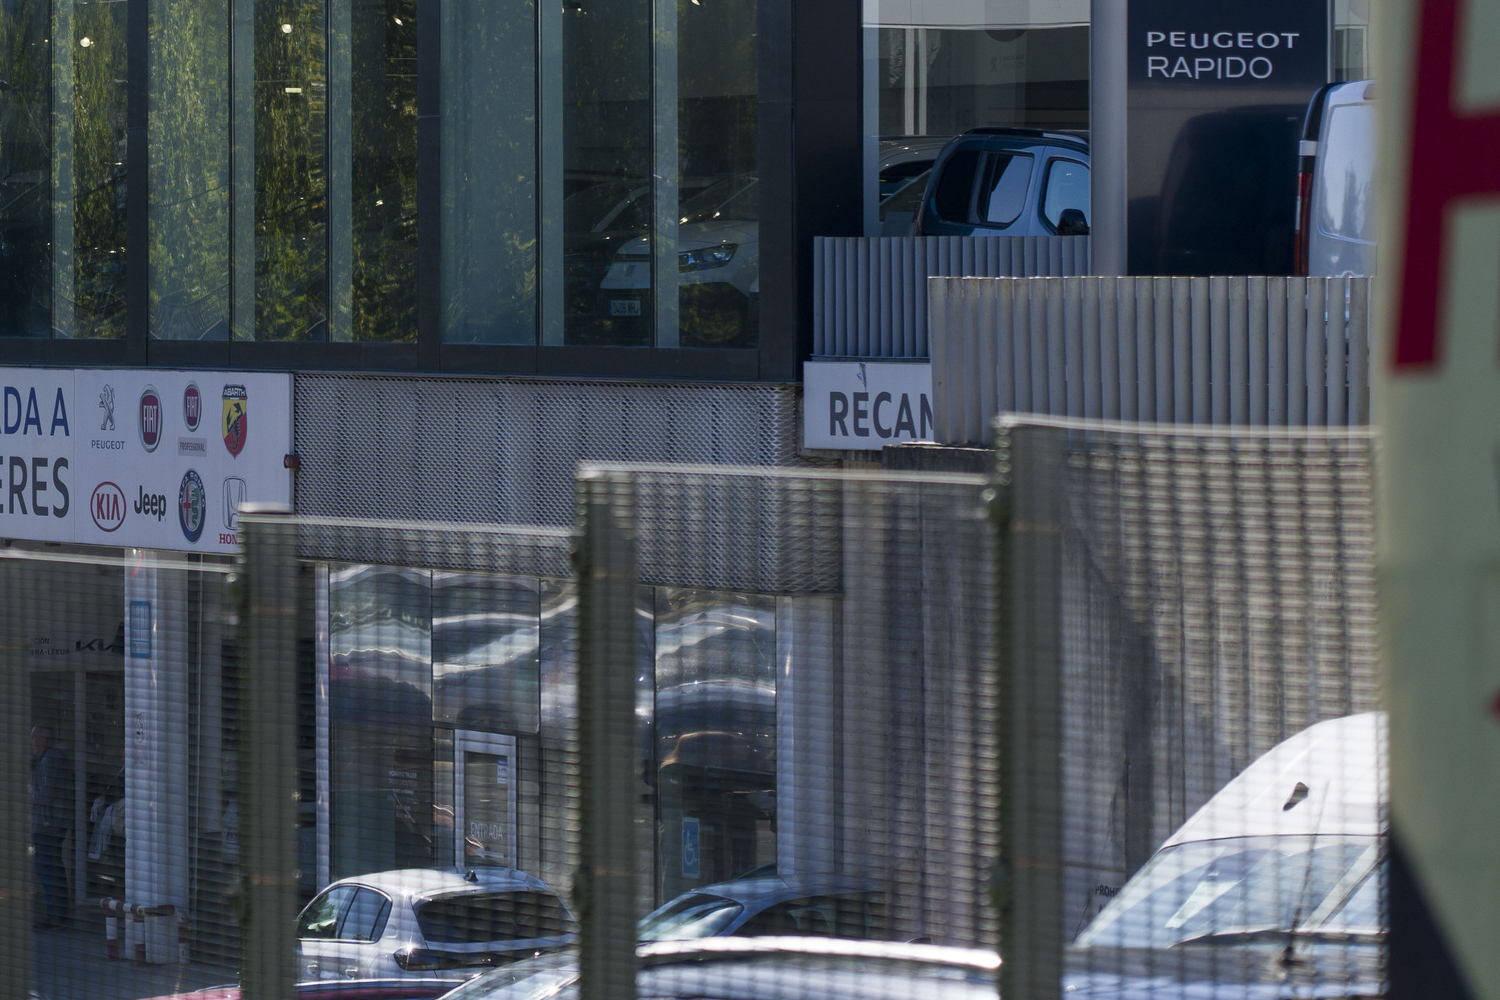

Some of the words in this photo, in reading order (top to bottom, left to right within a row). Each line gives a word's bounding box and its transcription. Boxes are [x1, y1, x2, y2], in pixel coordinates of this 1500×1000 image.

[1146, 31, 1300, 49] PEUGEOT
[1147, 56, 1273, 80] RAPIDO
[223, 387, 246, 397] ABARTH
[50, 387, 70, 437] A
[187, 396, 198, 418] FIAT
[143, 405, 157, 433] FIAT
[91, 439, 126, 450] PEUGEOT
[179, 441, 205, 452] PROFESSIONAL
[96, 493, 120, 521] KIA
[134, 485, 167, 522] Jeep
[470, 821, 503, 841] ENTRADA
